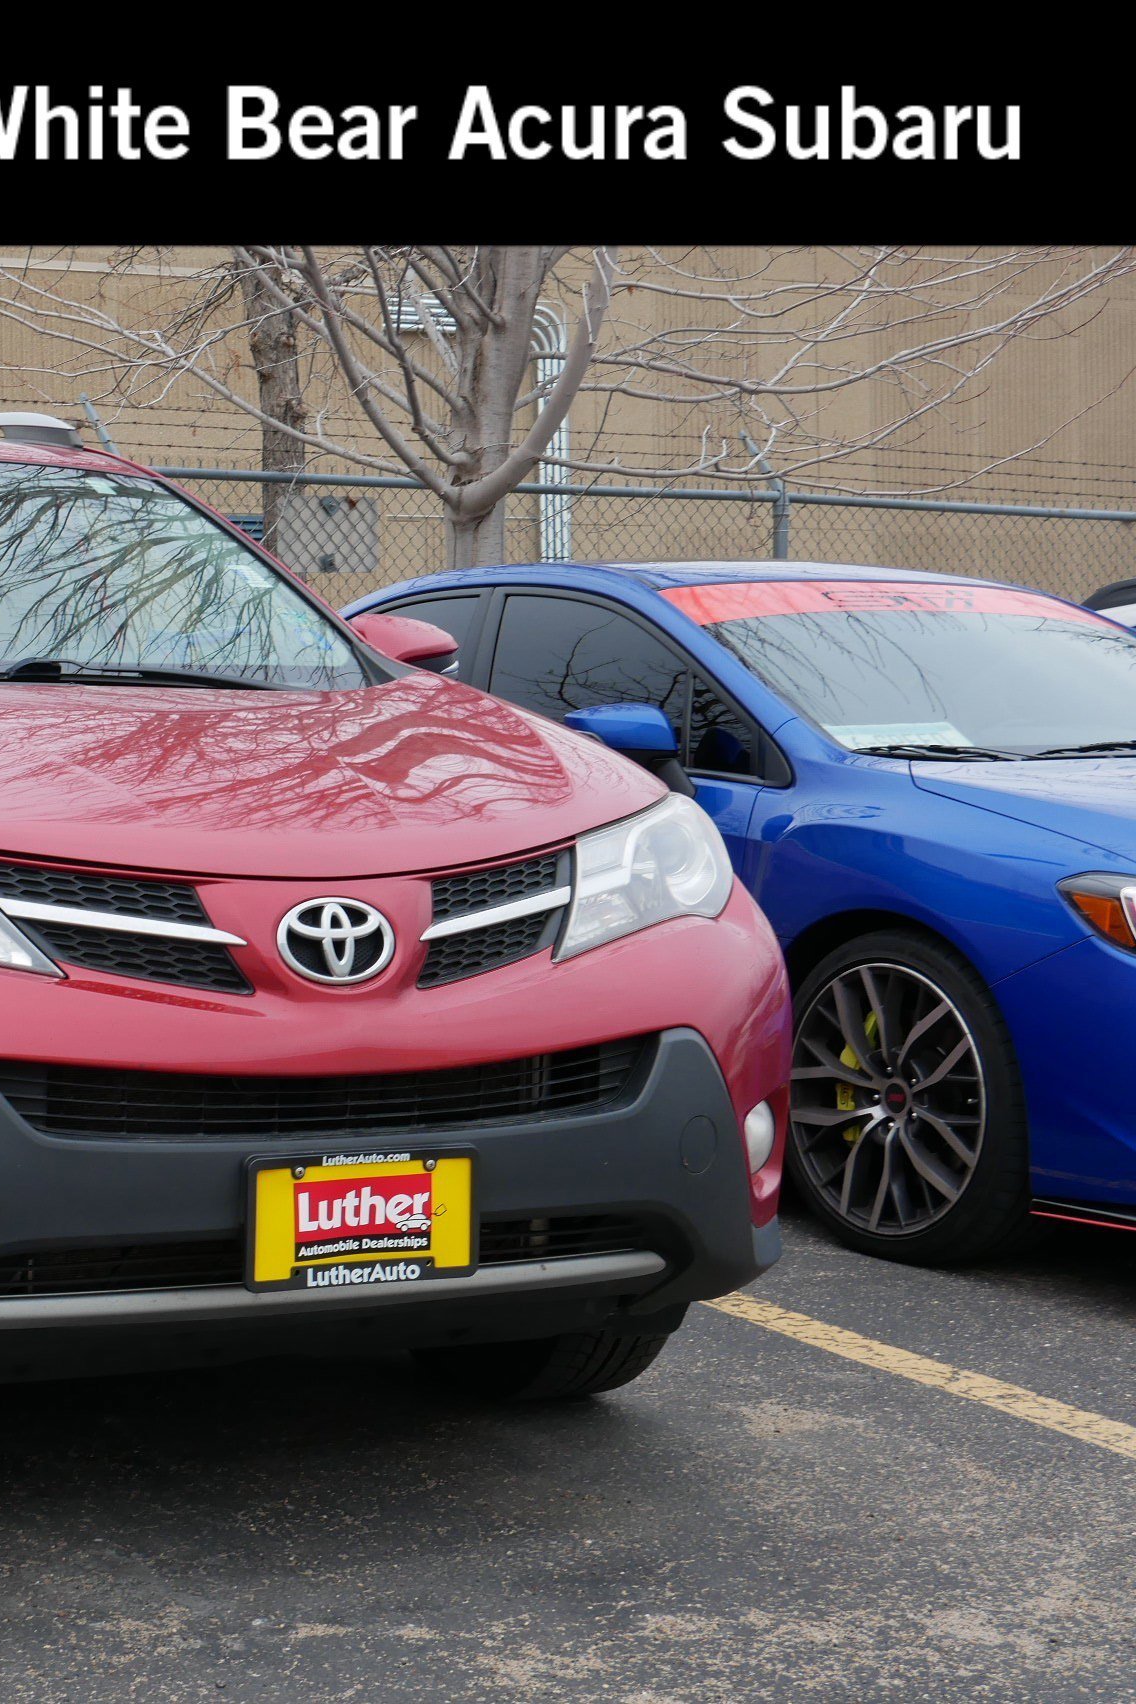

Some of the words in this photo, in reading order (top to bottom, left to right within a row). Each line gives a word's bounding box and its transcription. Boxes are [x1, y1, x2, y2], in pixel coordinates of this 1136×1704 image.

[322, 1152, 411, 1167] LutherAuto.com
[297, 1186, 431, 1233] Luther
[298, 1239, 360, 1257] Automobile
[361, 1235, 428, 1250] Dealerships
[306, 1262, 421, 1287] LutherAuto
